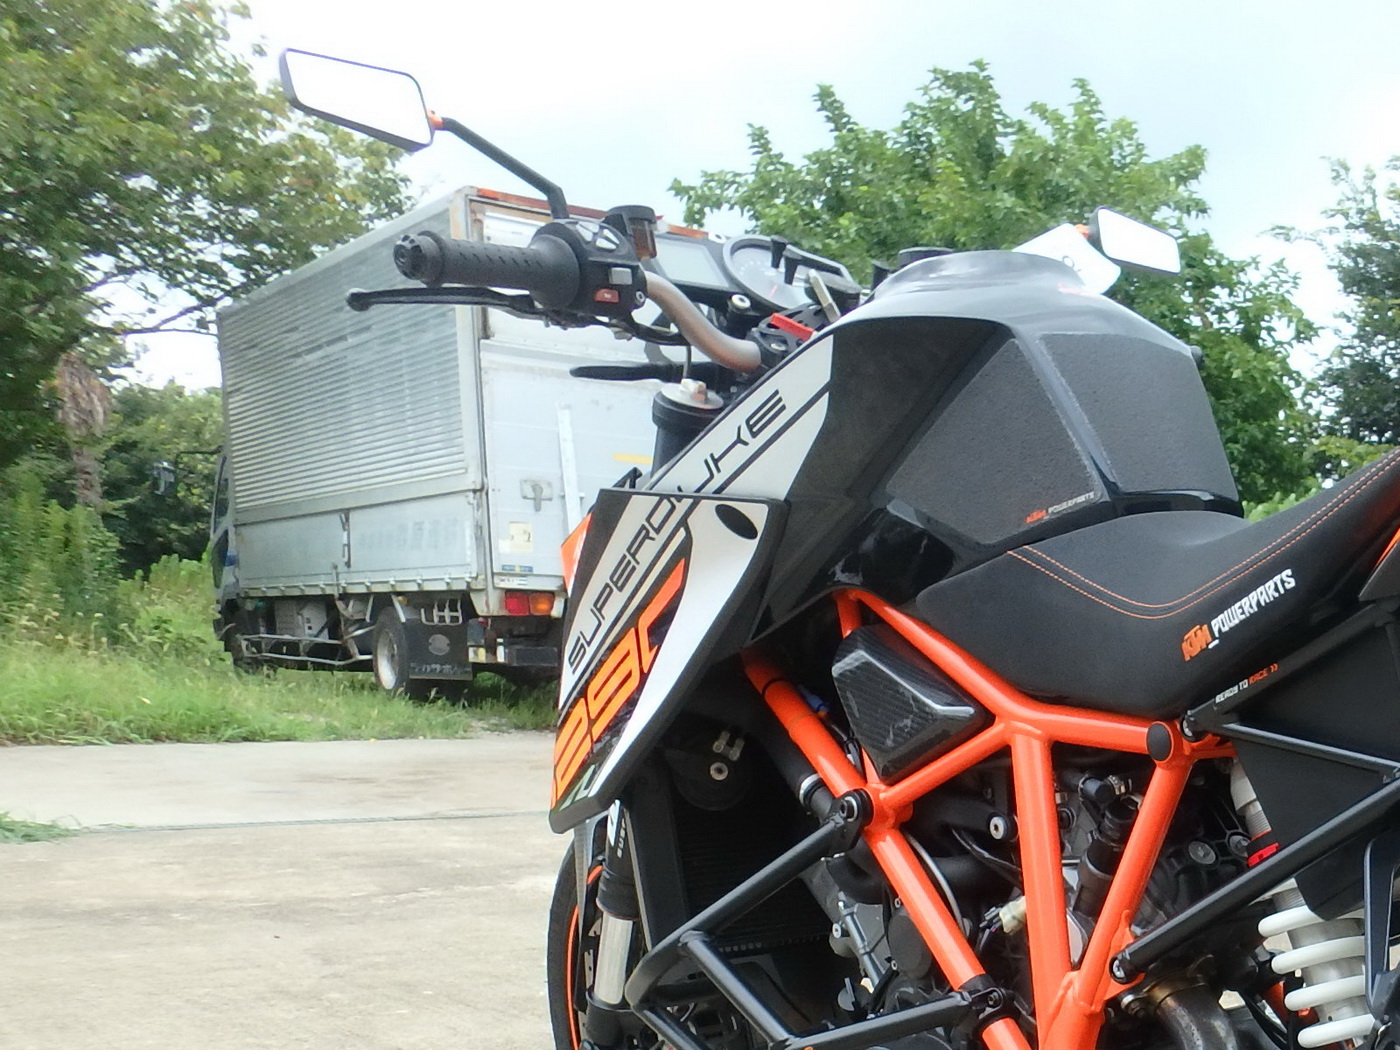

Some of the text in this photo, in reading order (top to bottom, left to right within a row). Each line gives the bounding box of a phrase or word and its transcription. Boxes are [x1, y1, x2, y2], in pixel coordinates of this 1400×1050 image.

[1181, 568, 1296, 662] KTM POWERPARTS
[1215, 668, 1269, 703] READY TO RACE
